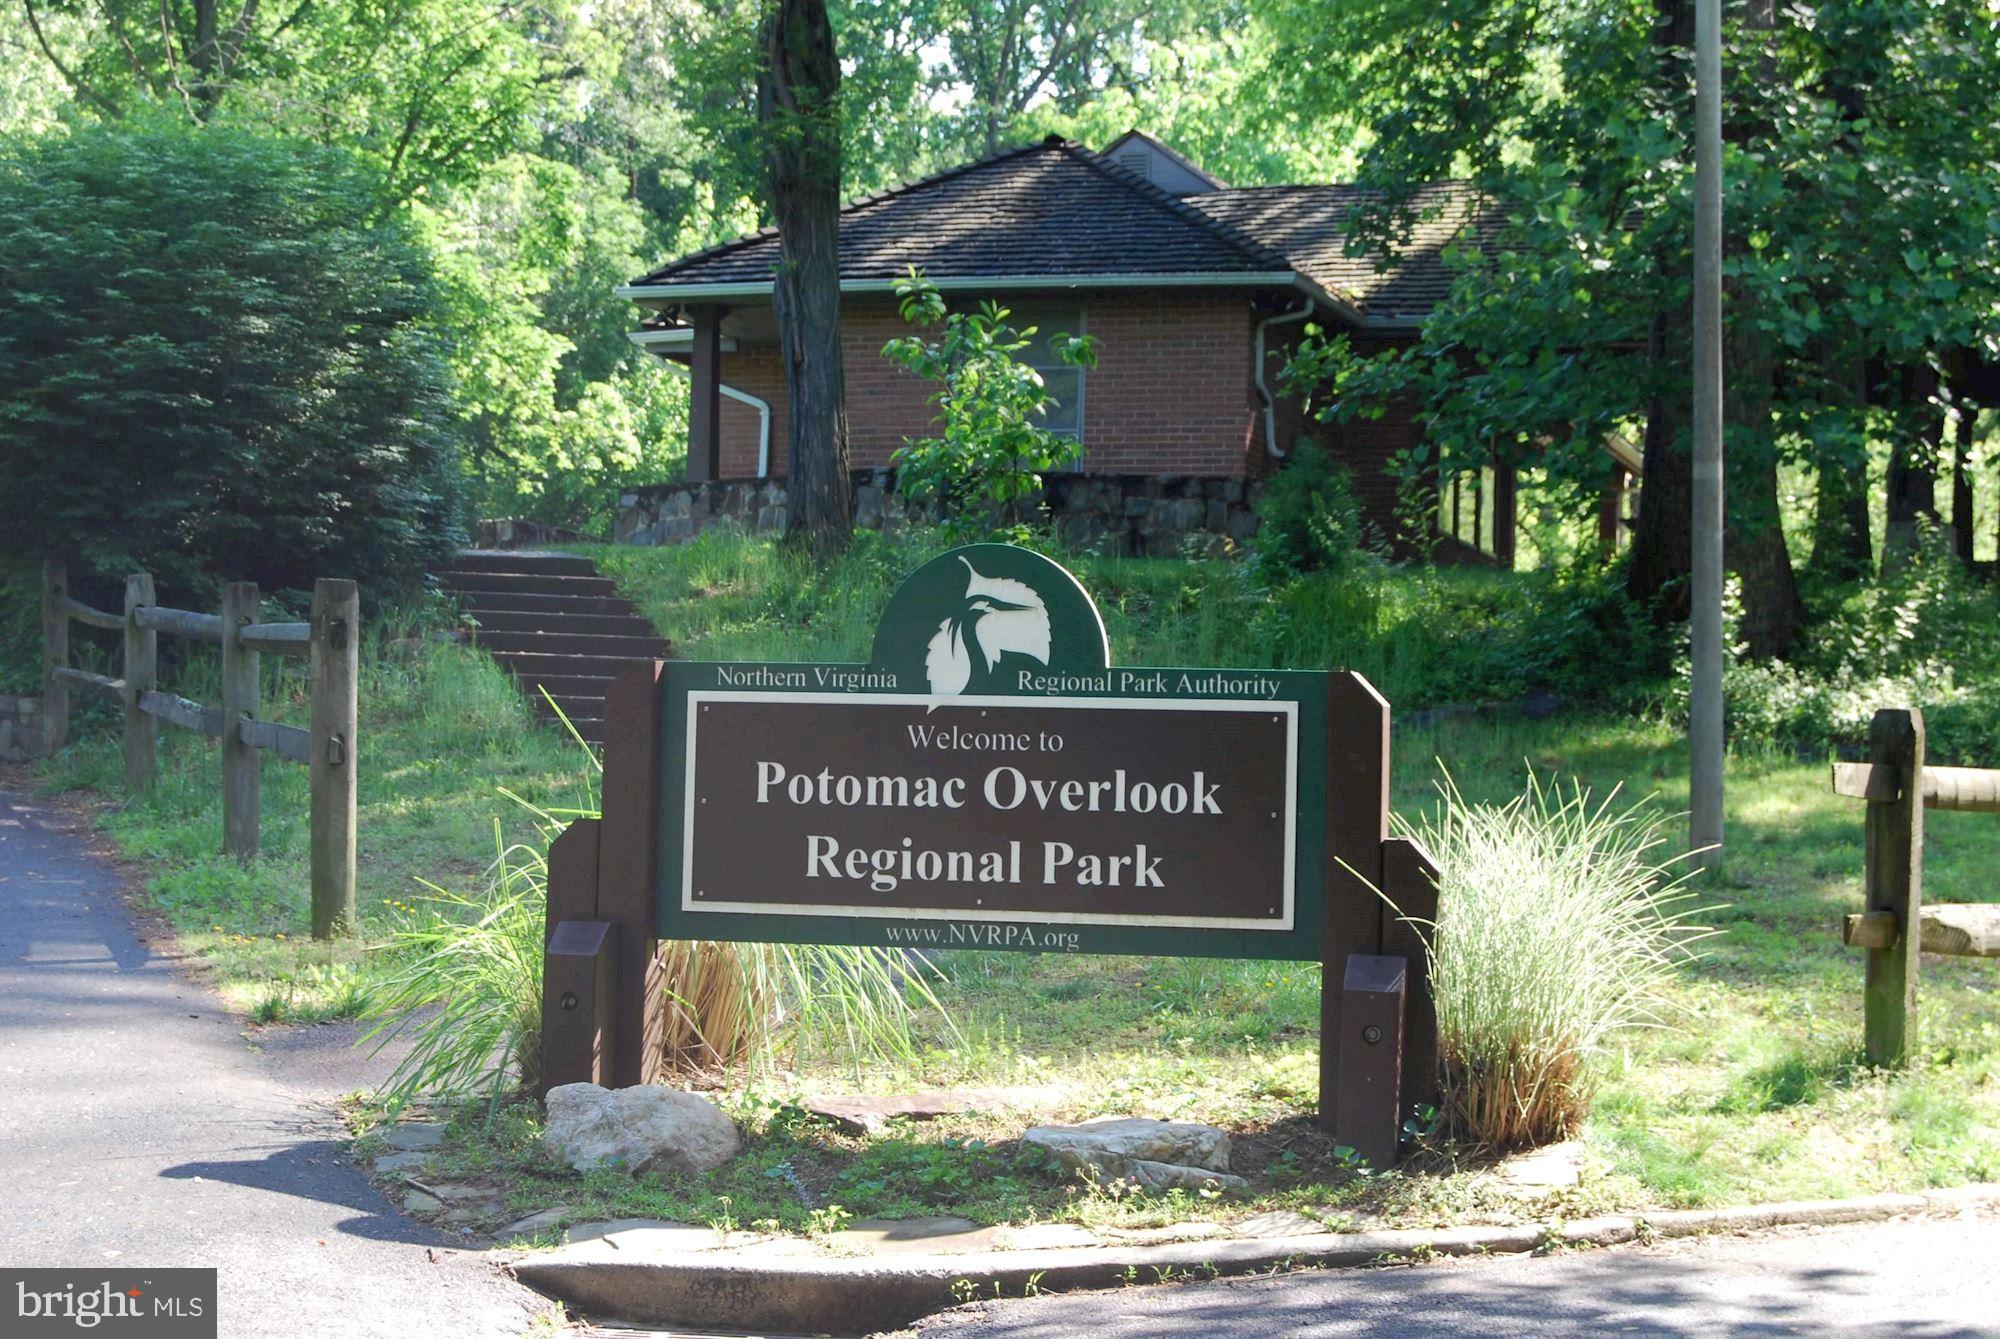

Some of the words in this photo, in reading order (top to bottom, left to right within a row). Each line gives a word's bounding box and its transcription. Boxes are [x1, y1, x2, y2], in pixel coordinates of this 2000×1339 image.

[716, 666, 807, 687] Northern
[814, 667, 898, 692] Virginia
[1017, 670, 1112, 695] Regional
[1120, 672, 1168, 693] Park
[1175, 674, 1282, 700] Authority
[907, 724, 1031, 751] Welcome
[1039, 731, 1064, 752] to
[756, 761, 966, 808] Potomac
[983, 766, 1223, 815] Overlook
[805, 835, 1021, 892] Regional
[1043, 841, 1165, 888] Park
[885, 922, 1080, 951] www.NVRPA.org
